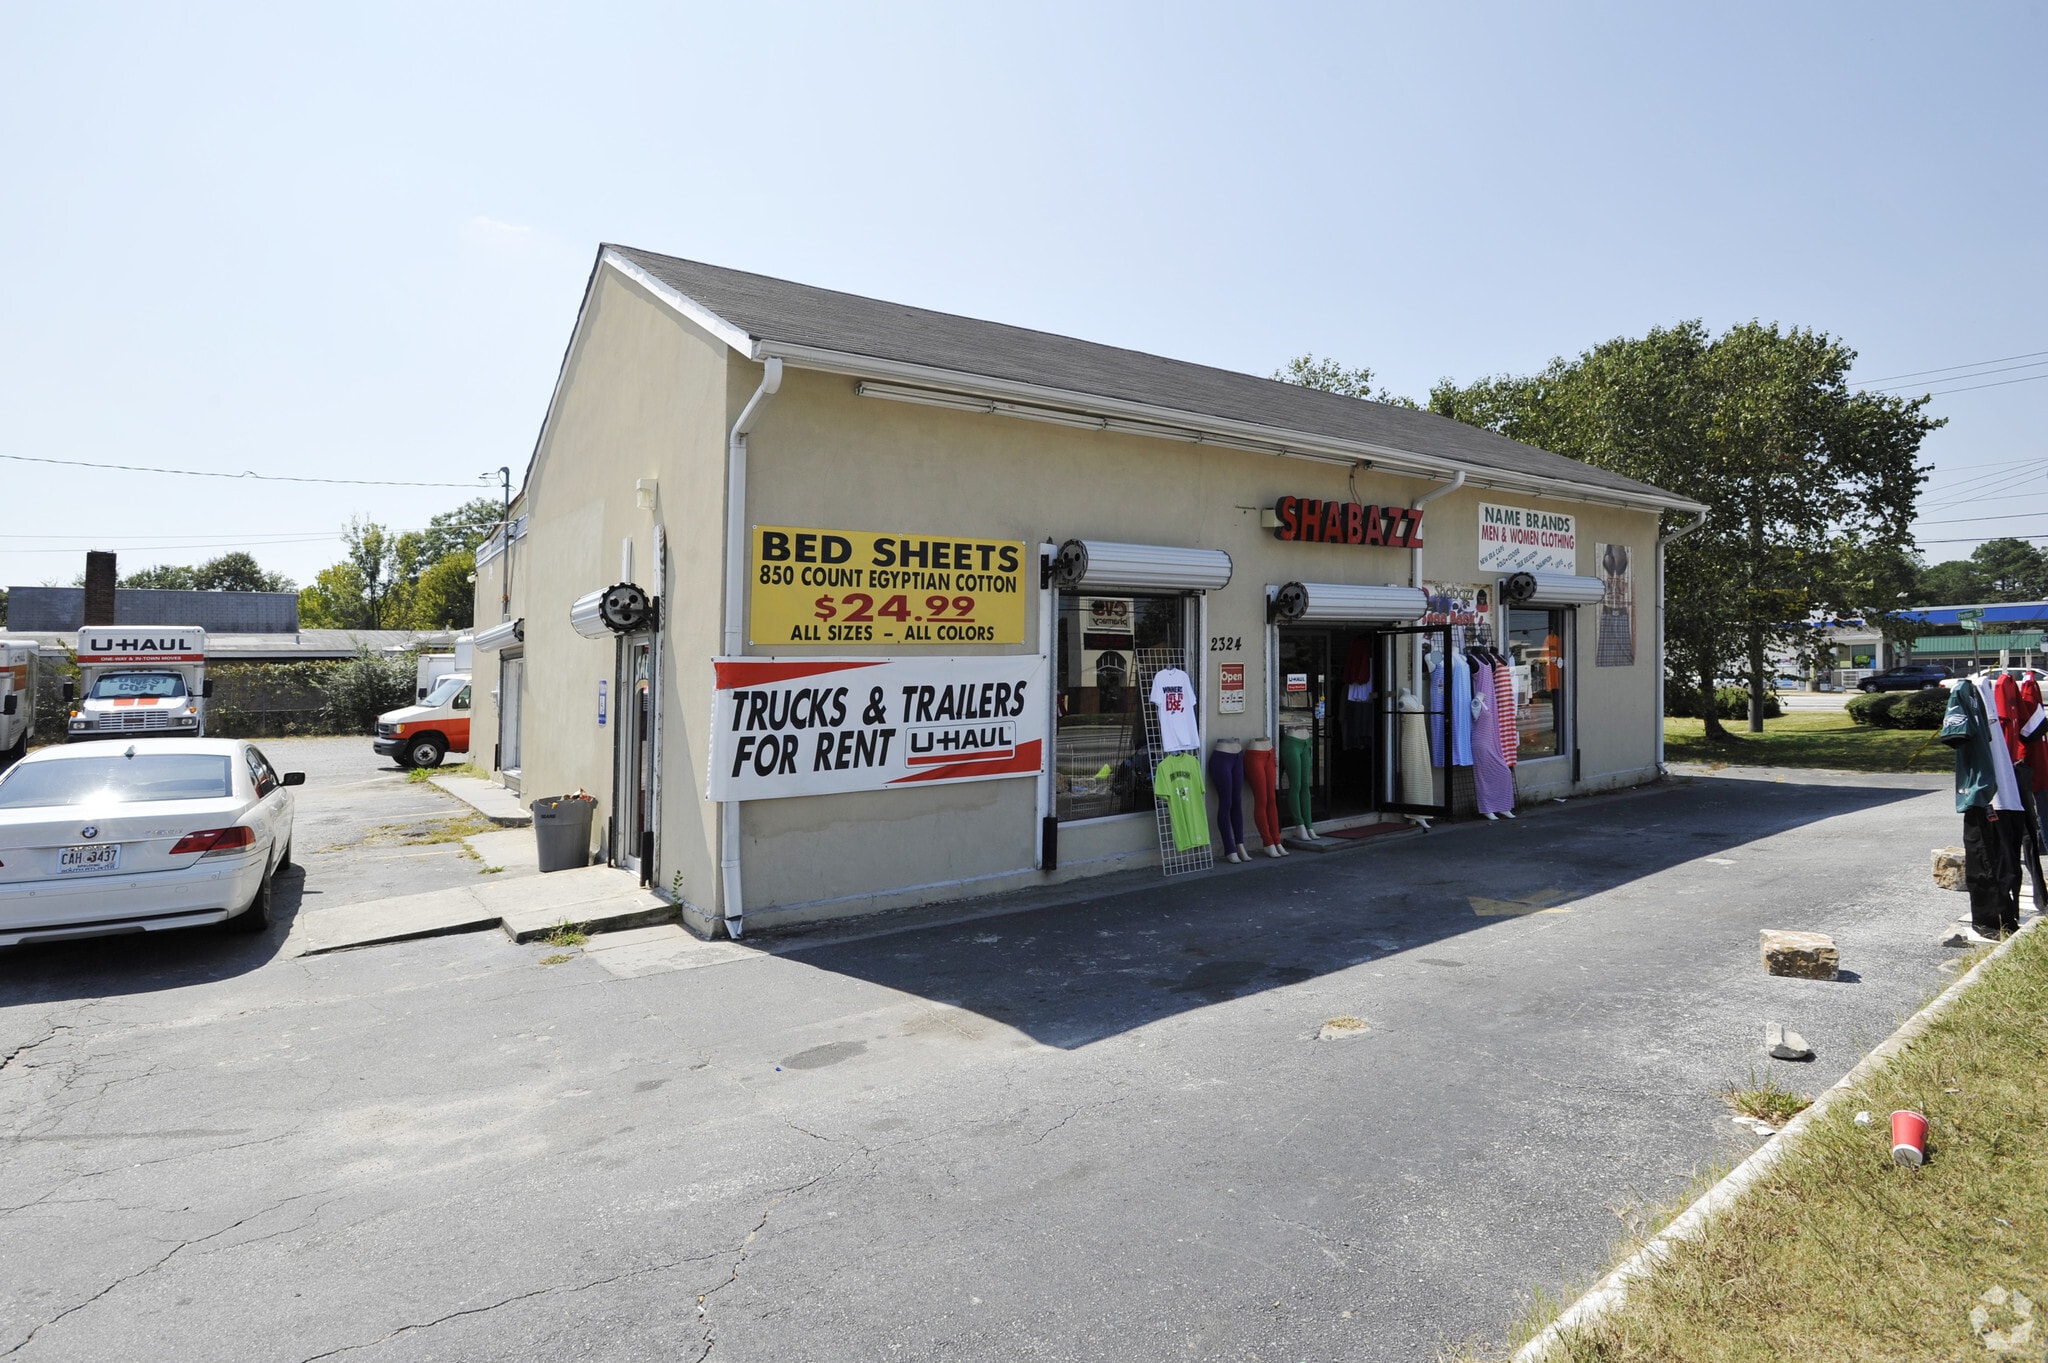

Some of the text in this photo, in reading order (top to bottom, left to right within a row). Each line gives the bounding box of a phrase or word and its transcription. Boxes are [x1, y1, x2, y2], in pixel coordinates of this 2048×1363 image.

[1275, 495, 1424, 548] SHABAZZ
[1484, 506, 1570, 532] NAME BRANDS
[1481, 525, 1574, 550] MEN & WOMEN CLOTHING
[762, 531, 1019, 573] BED SHEETS
[759, 564, 1016, 593] 850 COUNT EGYPTIAN COTTON
[1434, 583, 1474, 600] Shabazz
[814, 593, 976, 623] $24.99
[91, 638, 192, 651] U-HAUL
[790, 625, 821, 641] ALL
[828, 625, 873, 641] SIZES
[904, 625, 931, 641] ALL
[937, 626, 994, 641] COLORS
[1211, 637, 1242, 651] 2324
[109, 676, 167, 686] LOWEST
[119, 682, 157, 692] COST
[1221, 671, 1242, 683] Open
[731, 680, 1028, 731] TRUCKS & TRAILERS
[910, 727, 1012, 753] U-HAUL
[731, 728, 897, 778] FOR RENT
[61, 849, 117, 865] CAH 3437
